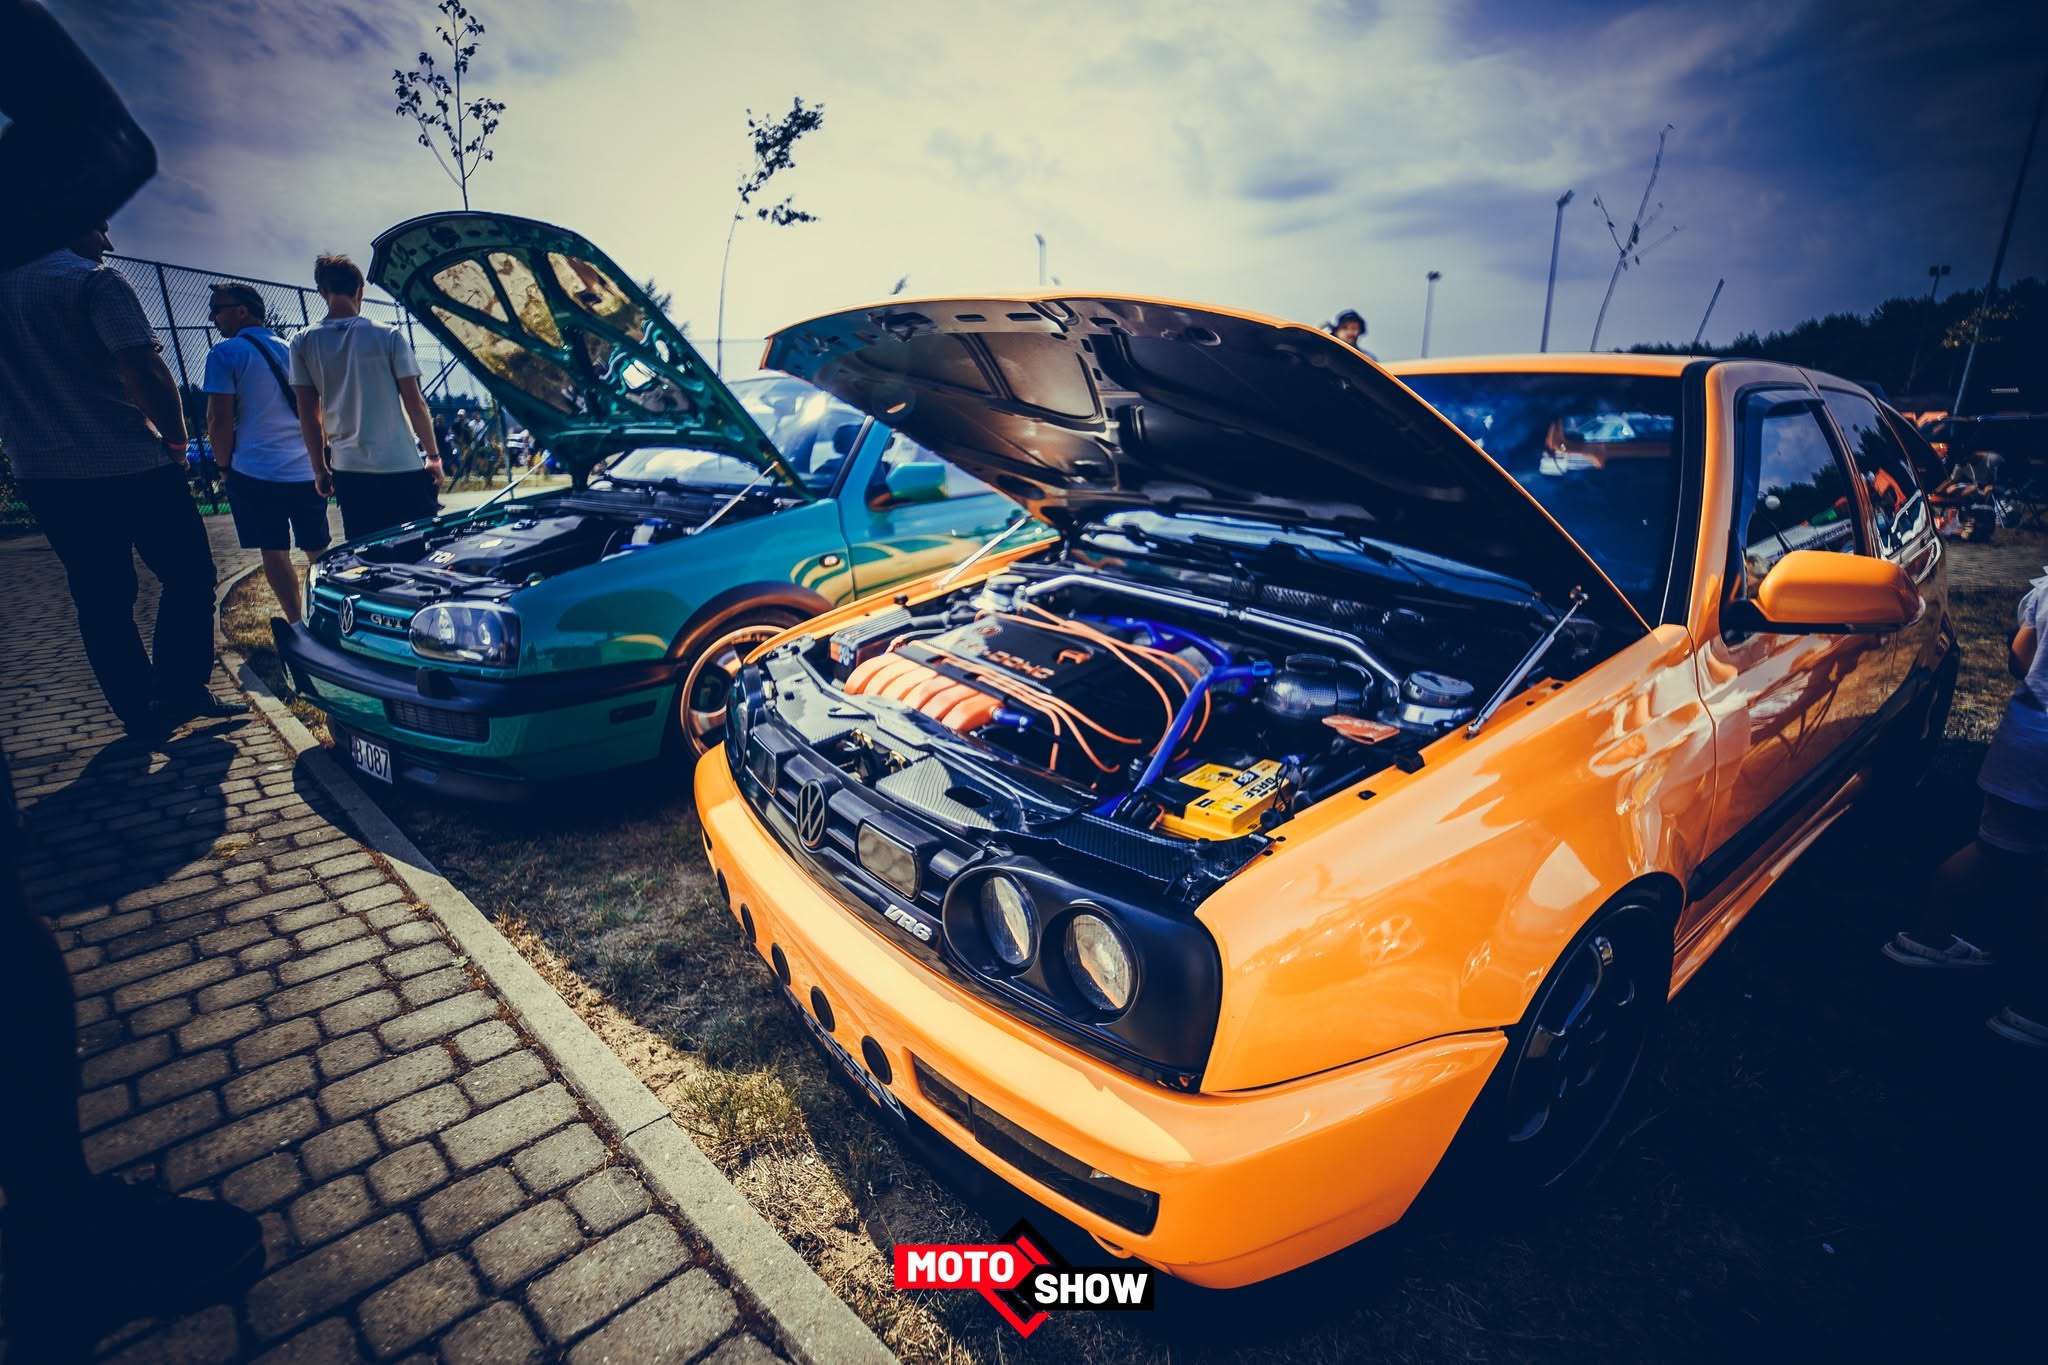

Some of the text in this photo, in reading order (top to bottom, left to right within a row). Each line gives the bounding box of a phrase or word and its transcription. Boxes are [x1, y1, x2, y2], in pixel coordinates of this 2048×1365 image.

[370, 613, 402, 629] GTI
[366, 744, 389, 778] 087
[884, 904, 933, 941] VR6
